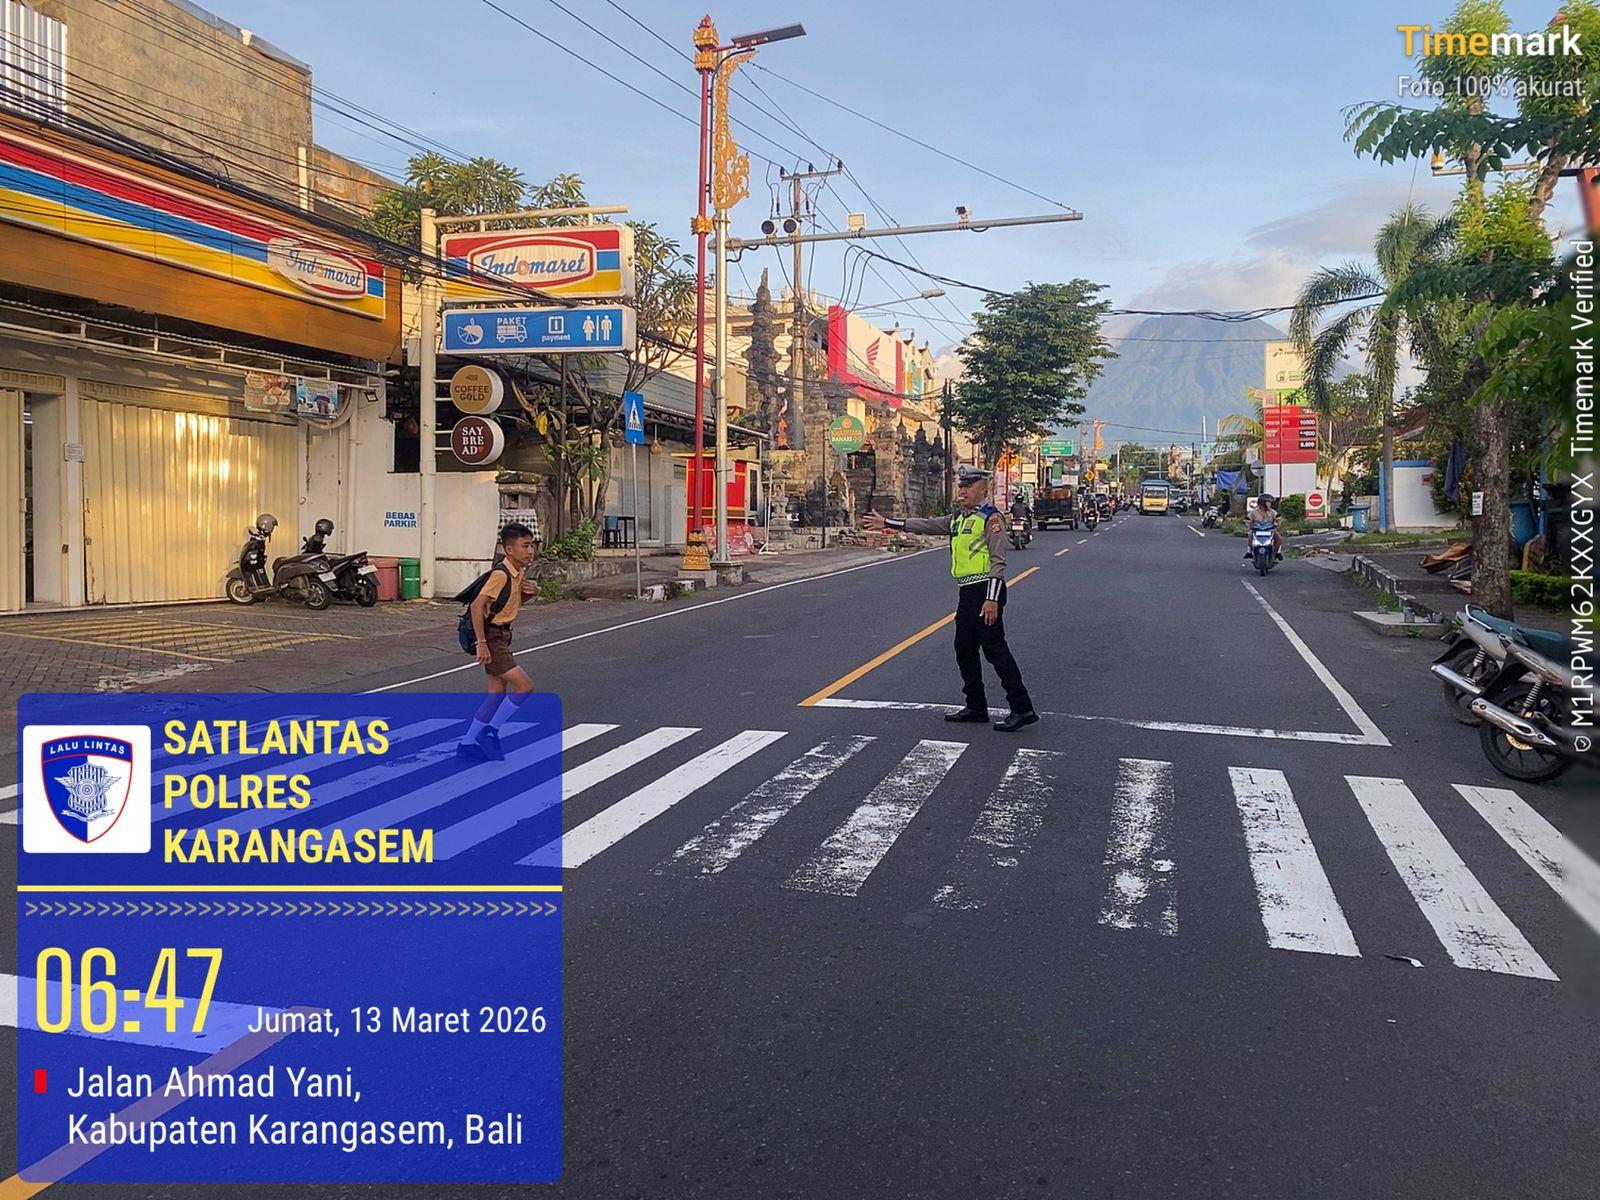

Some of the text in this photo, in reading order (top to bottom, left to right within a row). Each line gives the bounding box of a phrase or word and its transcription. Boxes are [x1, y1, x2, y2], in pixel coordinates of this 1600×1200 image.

[285, 249, 362, 287] Indomaret
[480, 252, 586, 277] Indomaret
[496, 316, 527, 326] PAKET
[541, 334, 571, 343] payment
[454, 385, 489, 393] COFFEE
[459, 393, 485, 401] GOLD
[462, 426, 484, 436] SAY
[462, 436, 485, 445] BRE
[461, 446, 478, 455] AD
[385, 511, 416, 520] BEBAS
[383, 520, 417, 528] PARKIR
